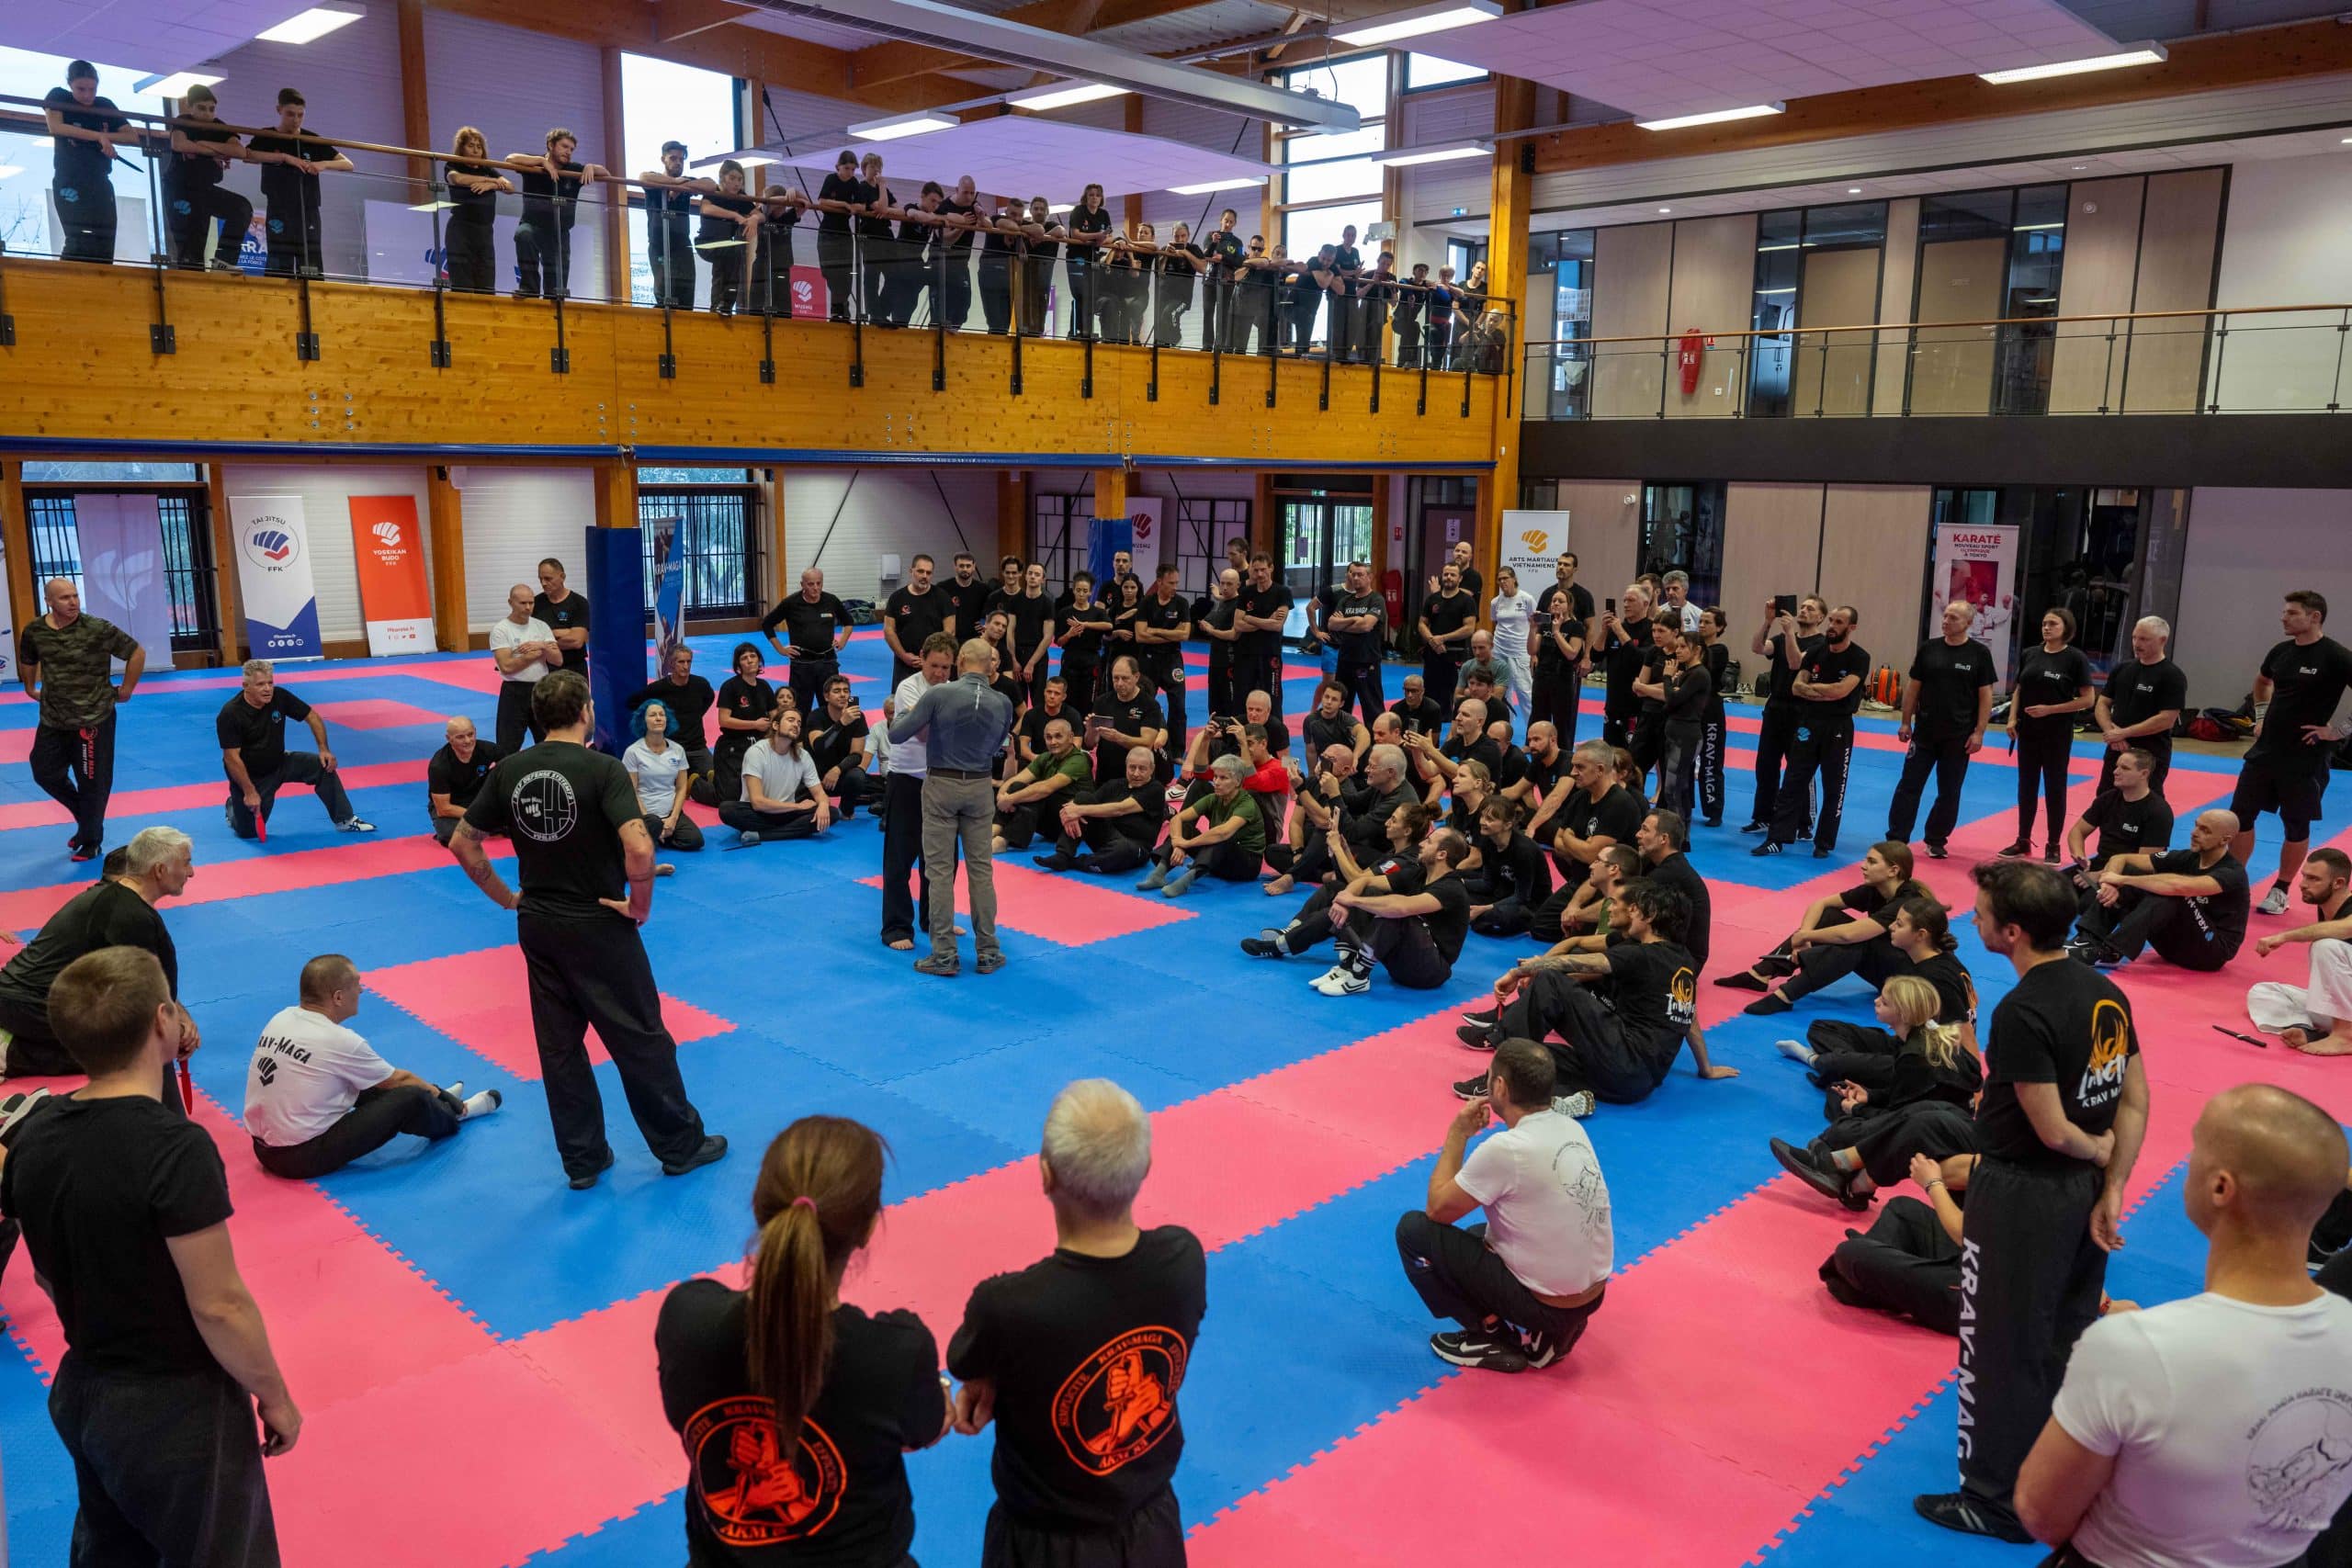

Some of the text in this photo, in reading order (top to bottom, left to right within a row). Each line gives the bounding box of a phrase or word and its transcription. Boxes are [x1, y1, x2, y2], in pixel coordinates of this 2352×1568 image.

[252, 515, 286, 525] TAI JITSU
[1952, 533, 2002, 545] KARATÉ
[1704, 722, 1718, 804] KRAV-MAGA
